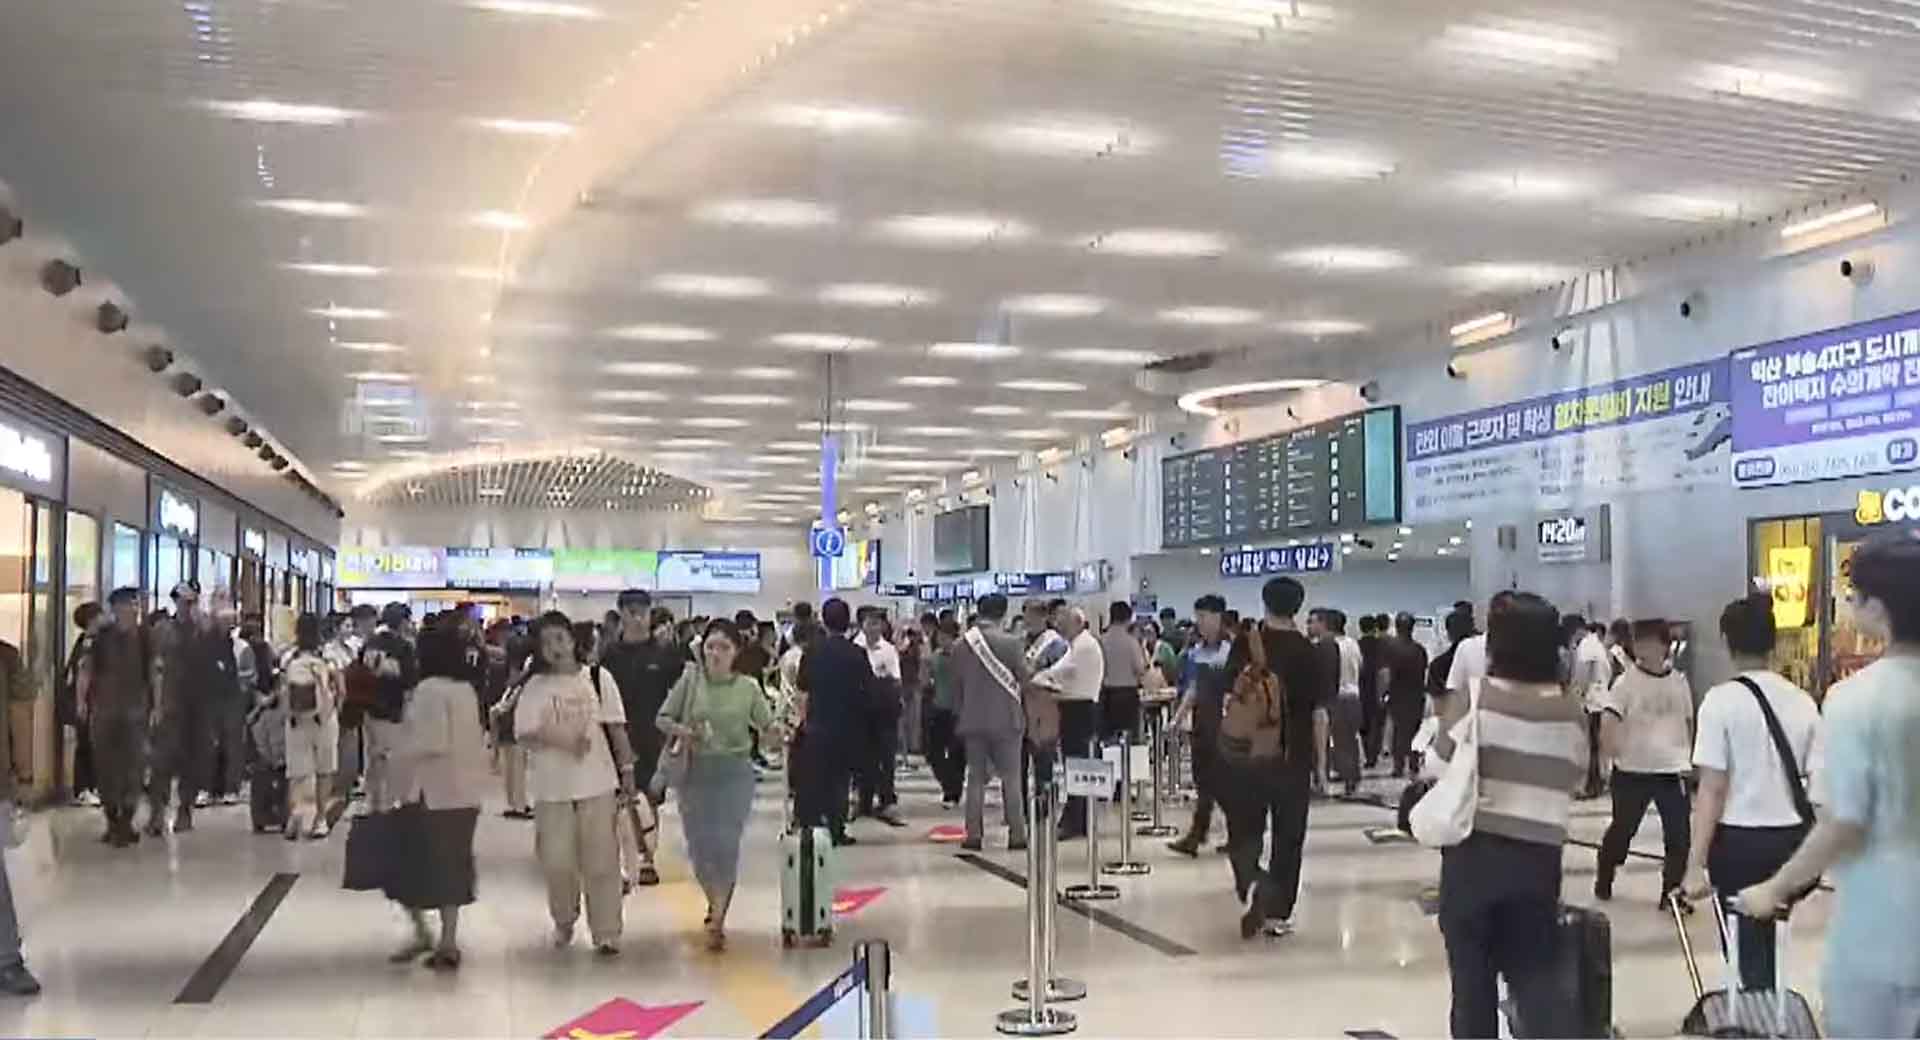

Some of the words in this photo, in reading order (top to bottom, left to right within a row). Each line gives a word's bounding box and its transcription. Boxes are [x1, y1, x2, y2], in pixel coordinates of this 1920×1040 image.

[1751, 356, 1782, 383] 익산
[1507, 410, 1521, 439] 및
[1634, 379, 1670, 414] 지원
[1674, 371, 1711, 408] 안내
